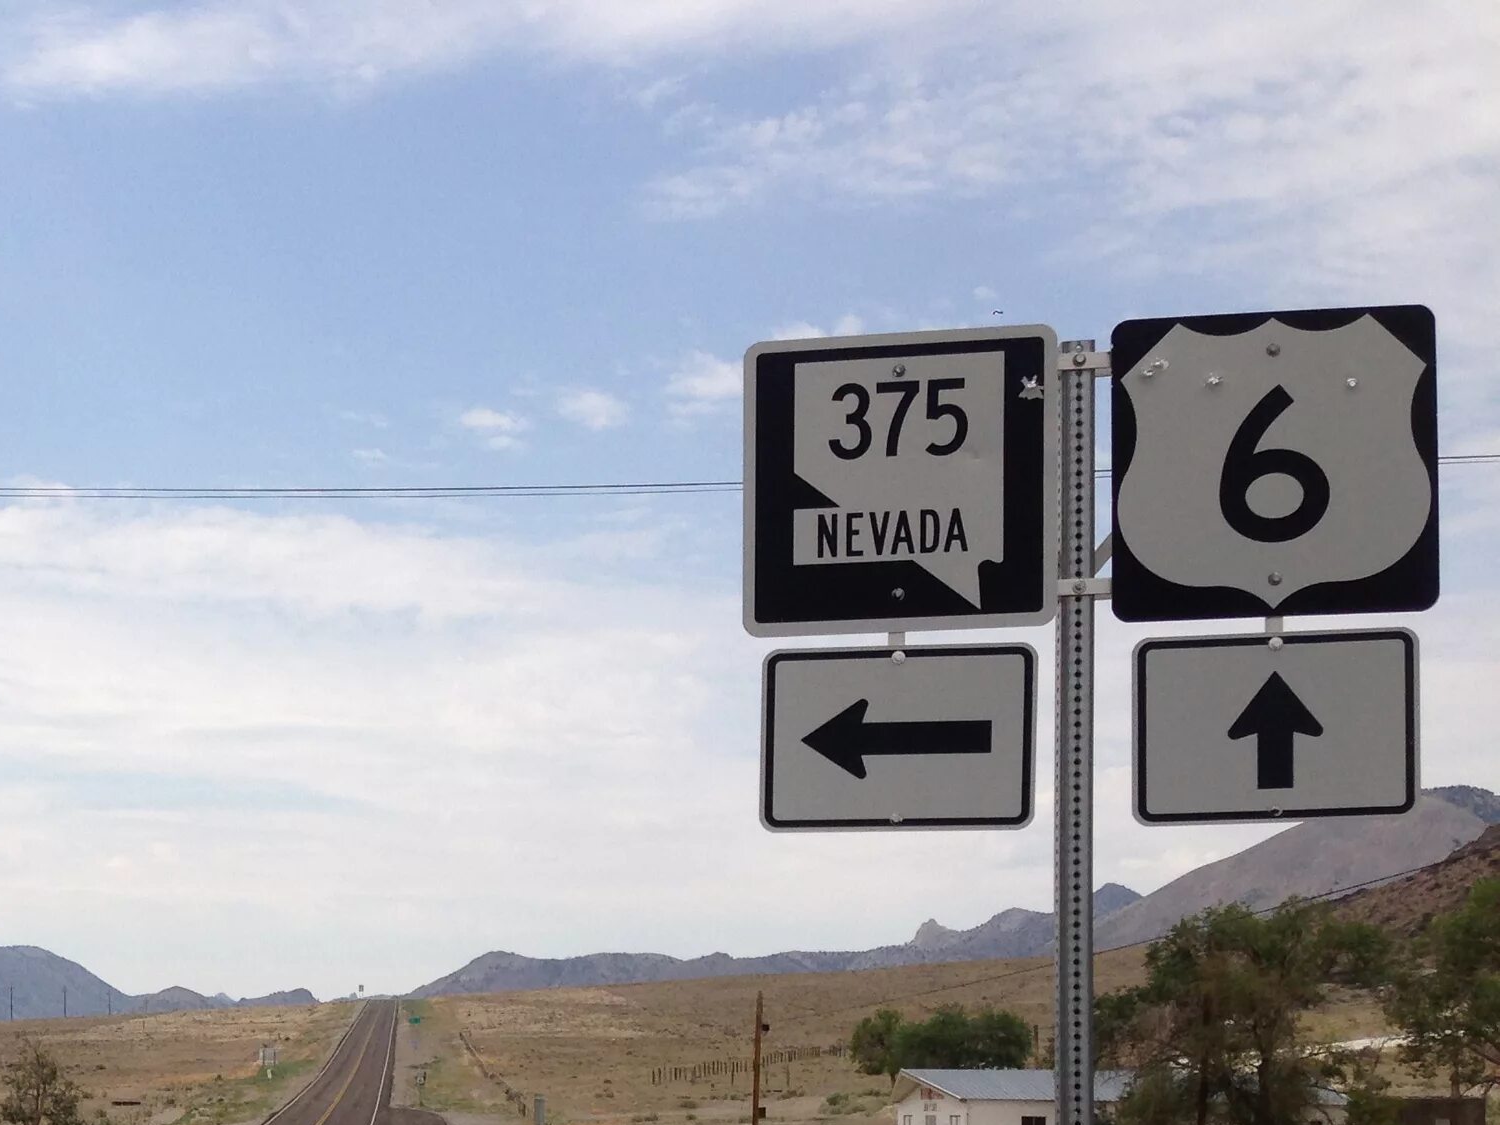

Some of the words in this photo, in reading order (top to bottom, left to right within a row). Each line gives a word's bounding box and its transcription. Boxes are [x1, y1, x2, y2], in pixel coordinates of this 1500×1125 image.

[828, 377, 969, 460] 375
[1219, 383, 1330, 543] 6
[817, 508, 968, 558] NEVADA
